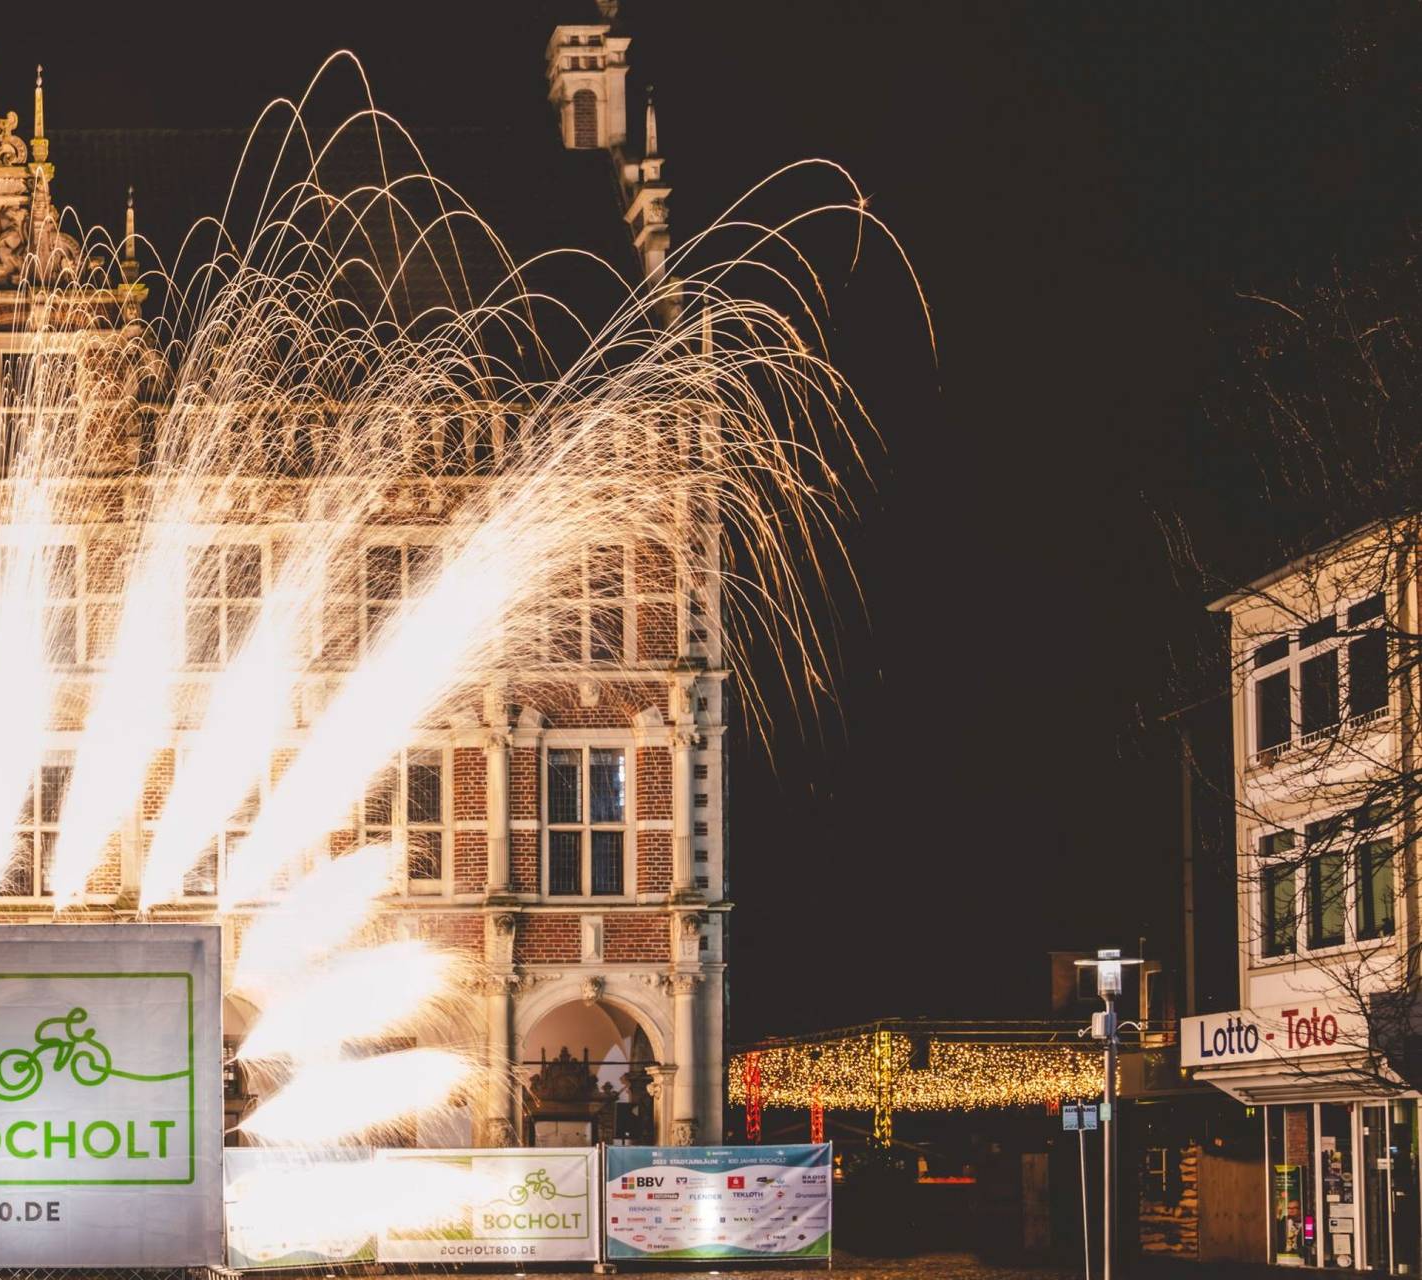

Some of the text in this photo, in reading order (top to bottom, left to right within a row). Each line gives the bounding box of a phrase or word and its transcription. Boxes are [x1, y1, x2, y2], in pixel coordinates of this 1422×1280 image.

[1199, 1019, 1258, 1058] Lotto
[1281, 1007, 1338, 1049] Toto
[636, 1176, 664, 1188] BBV
[483, 1212, 582, 1230] BOCHOLT
